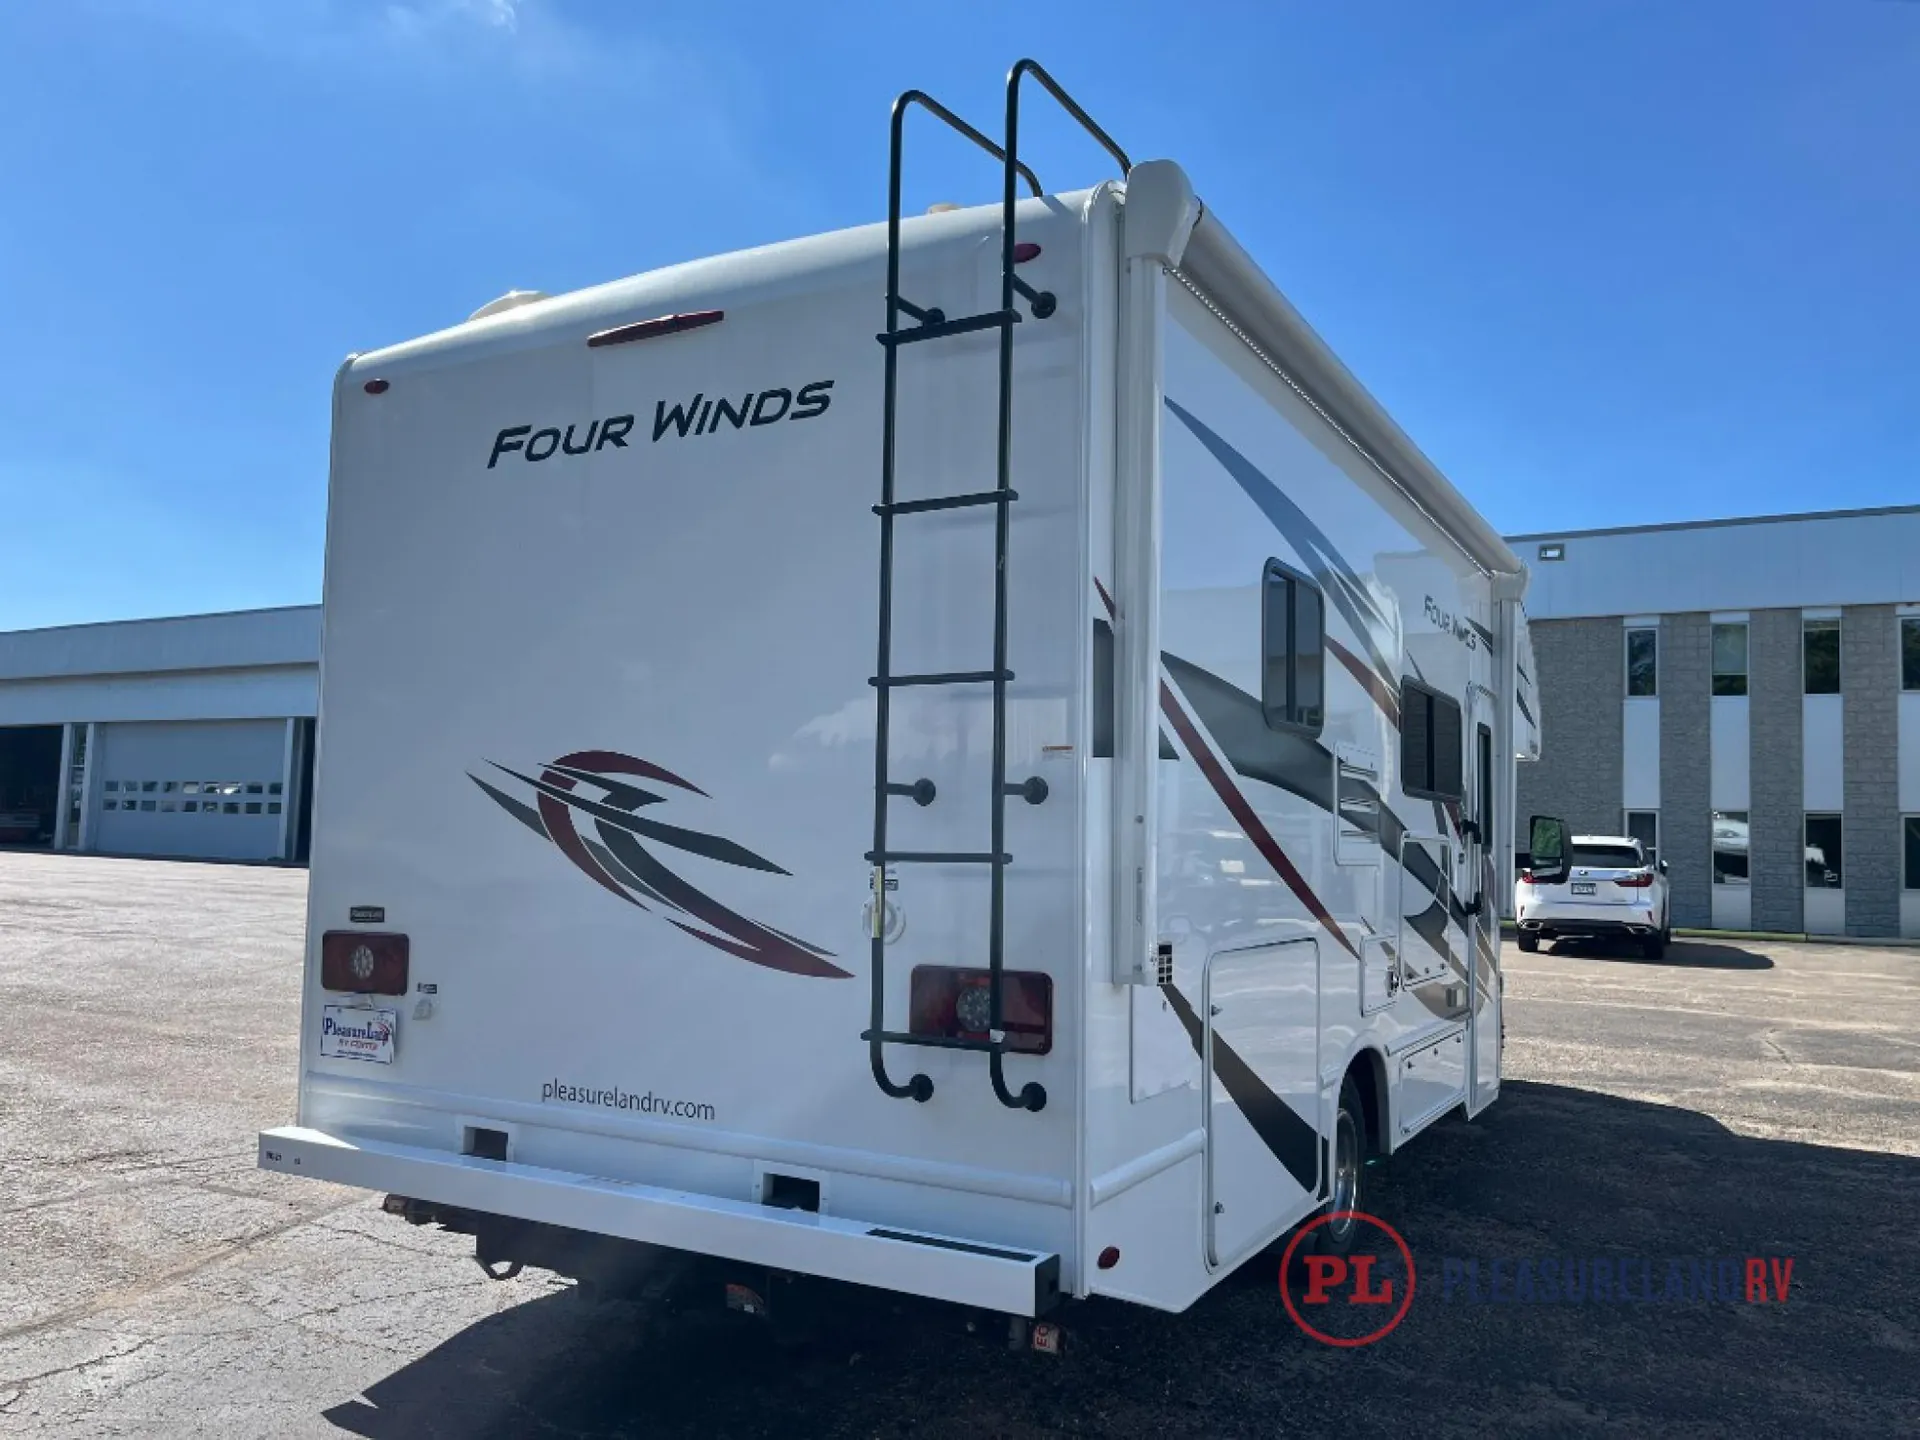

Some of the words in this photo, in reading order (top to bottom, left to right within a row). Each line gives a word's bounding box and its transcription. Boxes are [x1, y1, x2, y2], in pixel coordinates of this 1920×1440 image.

[487, 414, 635, 469] FOUR
[652, 379, 835, 443] WINDS
[1424, 594, 1451, 634] FOUR
[542, 1077, 716, 1121] pleasurelandrv.com
